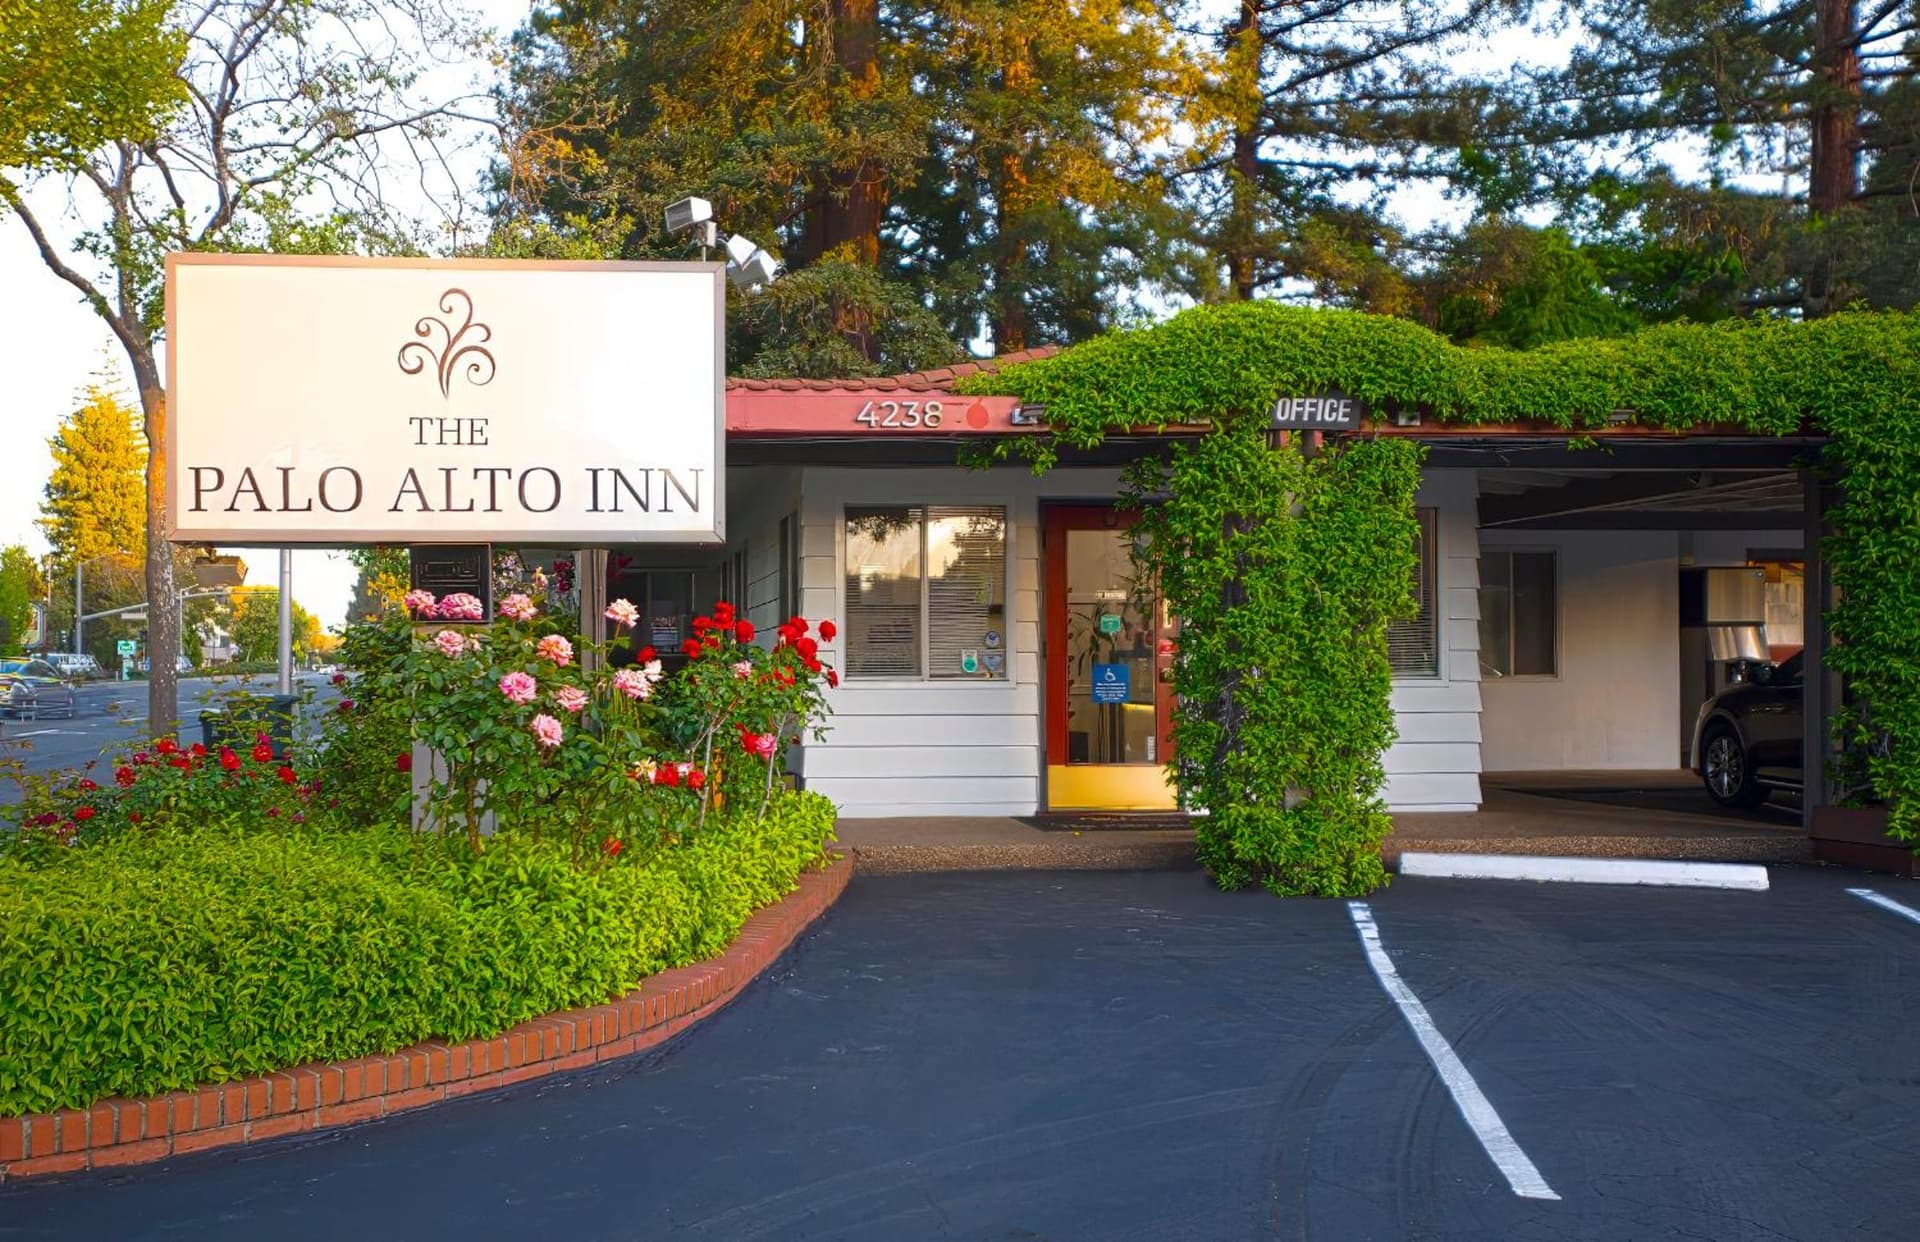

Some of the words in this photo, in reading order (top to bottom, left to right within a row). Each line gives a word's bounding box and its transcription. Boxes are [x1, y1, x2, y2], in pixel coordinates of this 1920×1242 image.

[857, 400, 943, 428] 4238
[1276, 397, 1353, 422] OFFICE
[409, 416, 489, 446] THE
[187, 466, 363, 512] PALO
[387, 466, 562, 512] ALTO
[585, 467, 704, 512] INN
